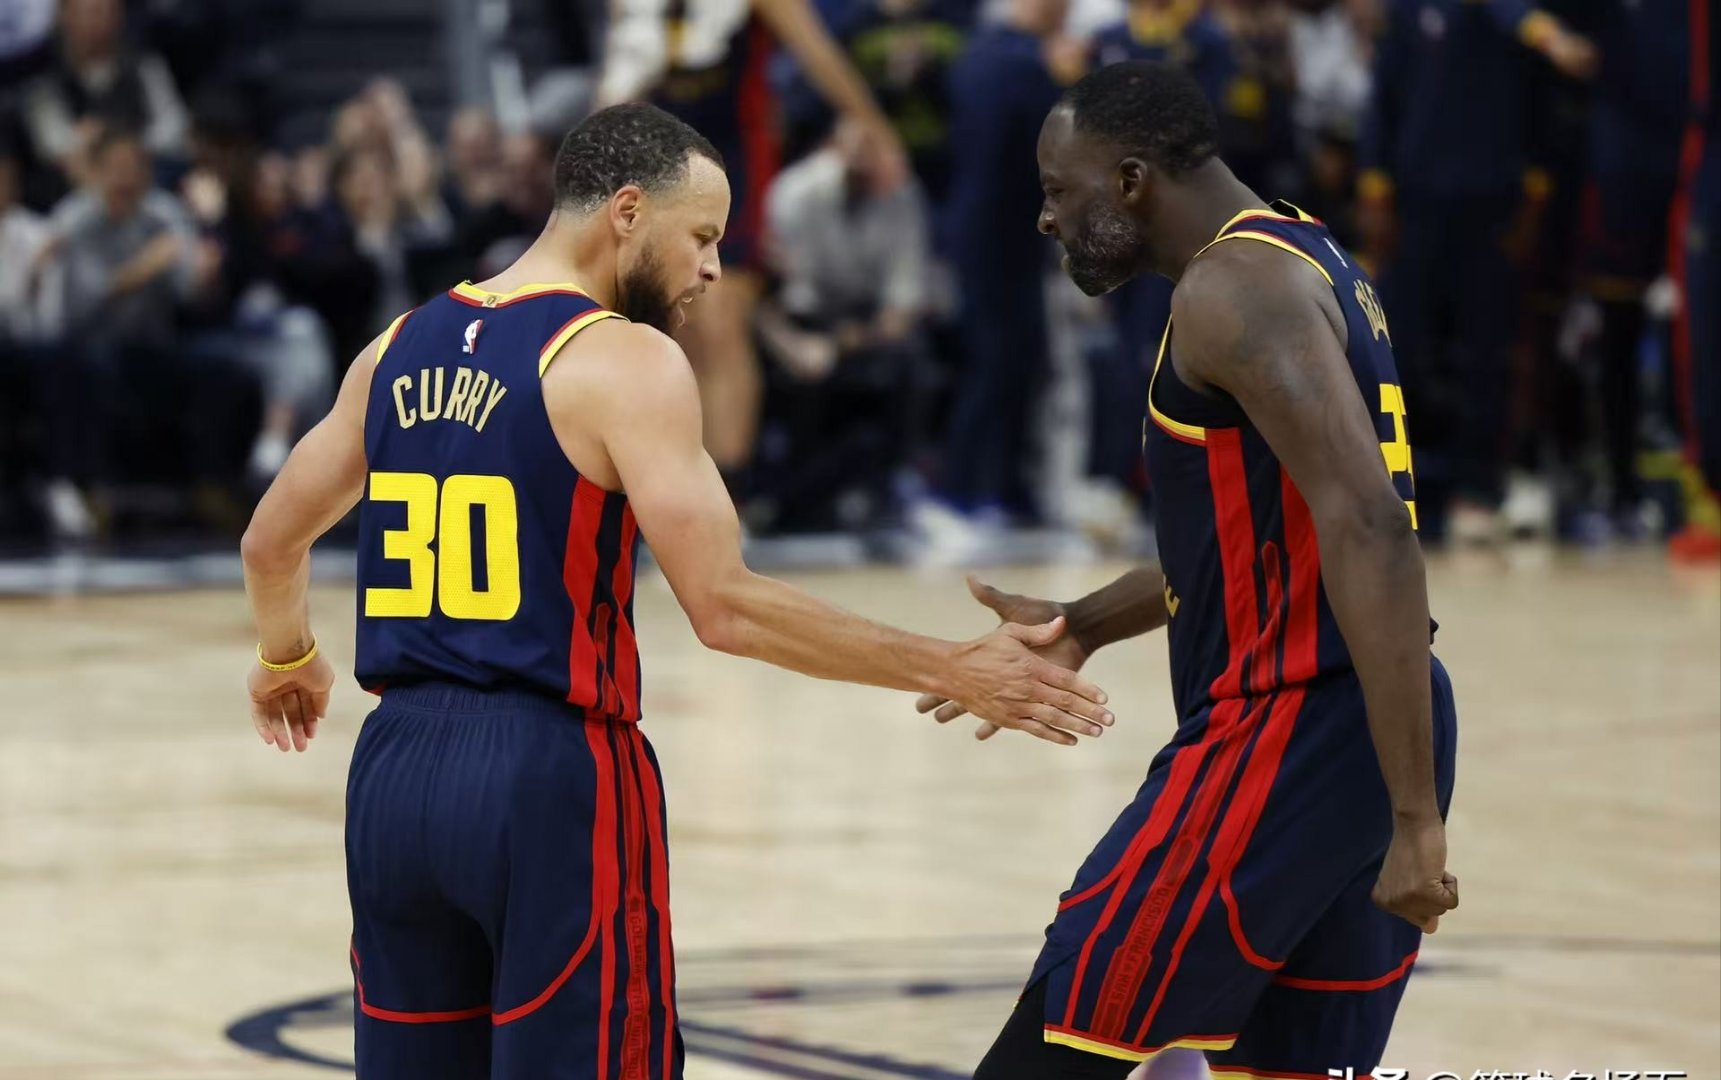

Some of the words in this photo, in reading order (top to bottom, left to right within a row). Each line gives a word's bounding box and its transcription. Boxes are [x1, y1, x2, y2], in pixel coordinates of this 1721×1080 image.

[392, 366, 507, 433] CURRY
[1379, 384, 1418, 530] 2
[365, 472, 521, 620] 30
